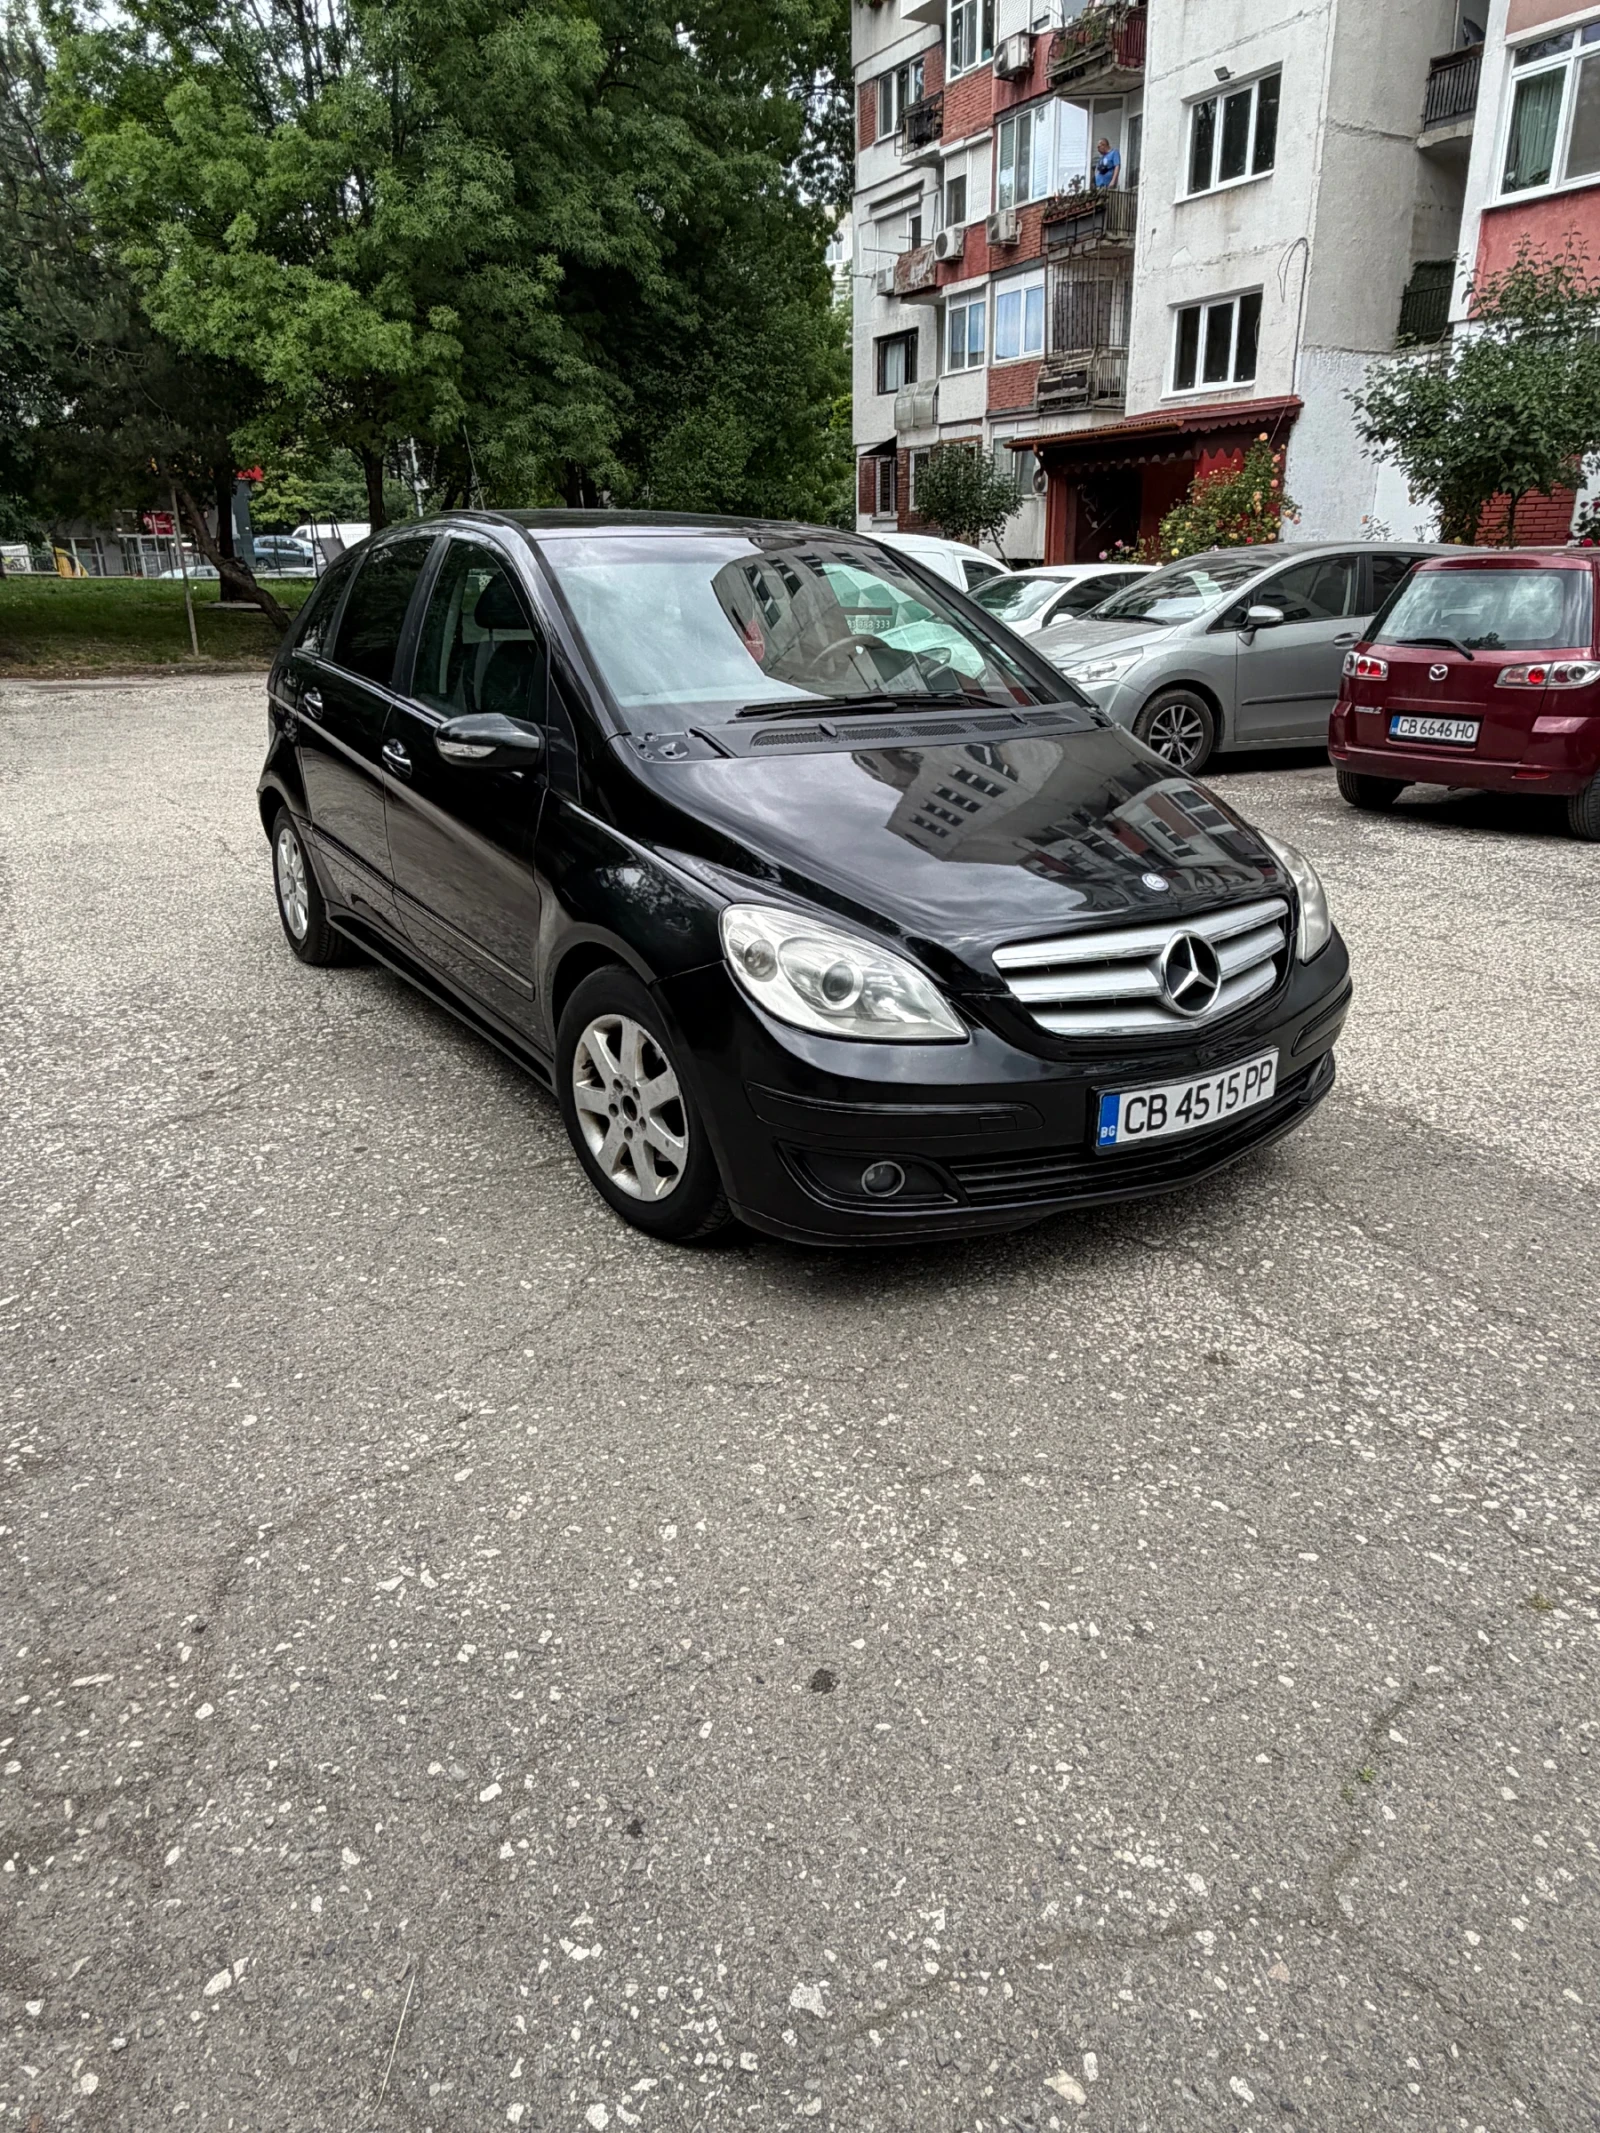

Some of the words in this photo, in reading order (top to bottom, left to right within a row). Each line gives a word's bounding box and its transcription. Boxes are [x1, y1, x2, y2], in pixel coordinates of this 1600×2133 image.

[1399, 719, 1418, 734] CB
[1419, 720, 1453, 737] 6646
[1454, 723, 1475, 739] HO
[1124, 1094, 1168, 1134] CB
[1175, 1072, 1241, 1124] 4515
[1243, 1059, 1273, 1103] PP
[1101, 1125, 1116, 1138] BG
